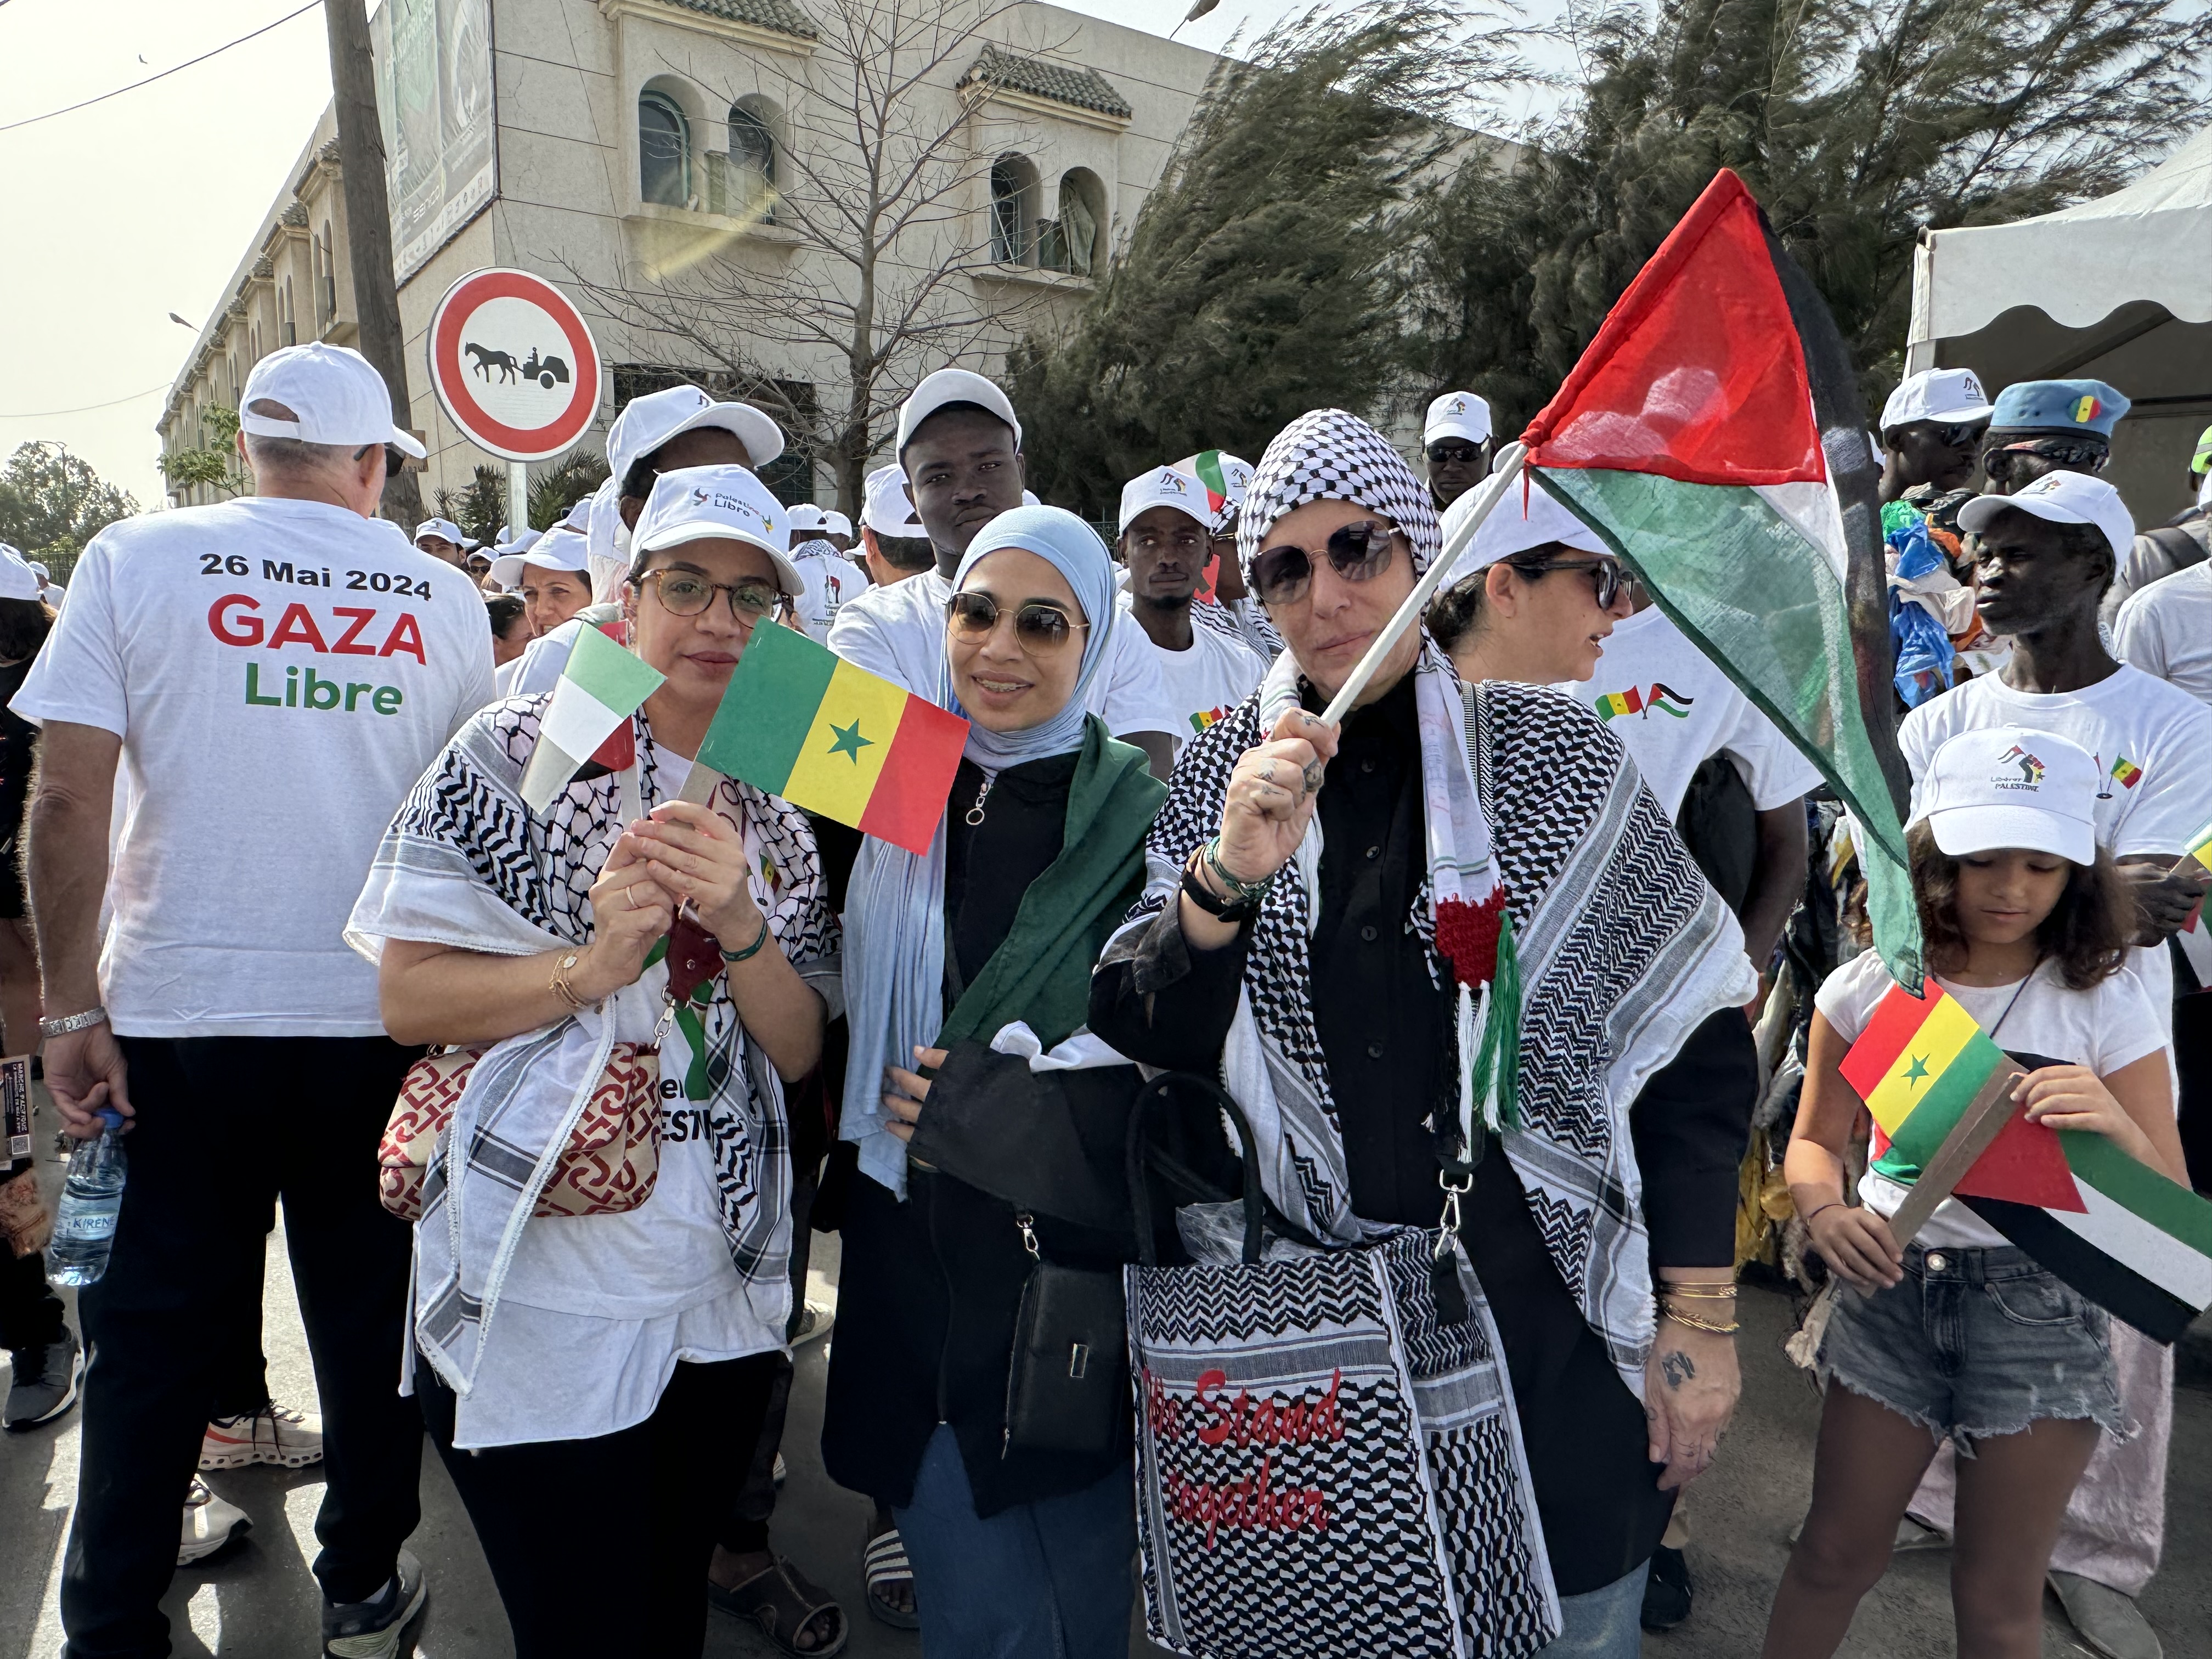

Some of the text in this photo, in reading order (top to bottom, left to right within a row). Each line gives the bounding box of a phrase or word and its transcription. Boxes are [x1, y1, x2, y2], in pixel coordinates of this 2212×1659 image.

[199, 554, 432, 601] 26 Mai 2024
[208, 594, 427, 665] GAZA
[245, 662, 403, 715] Libre
[1197, 1367, 1347, 1447] Stand
